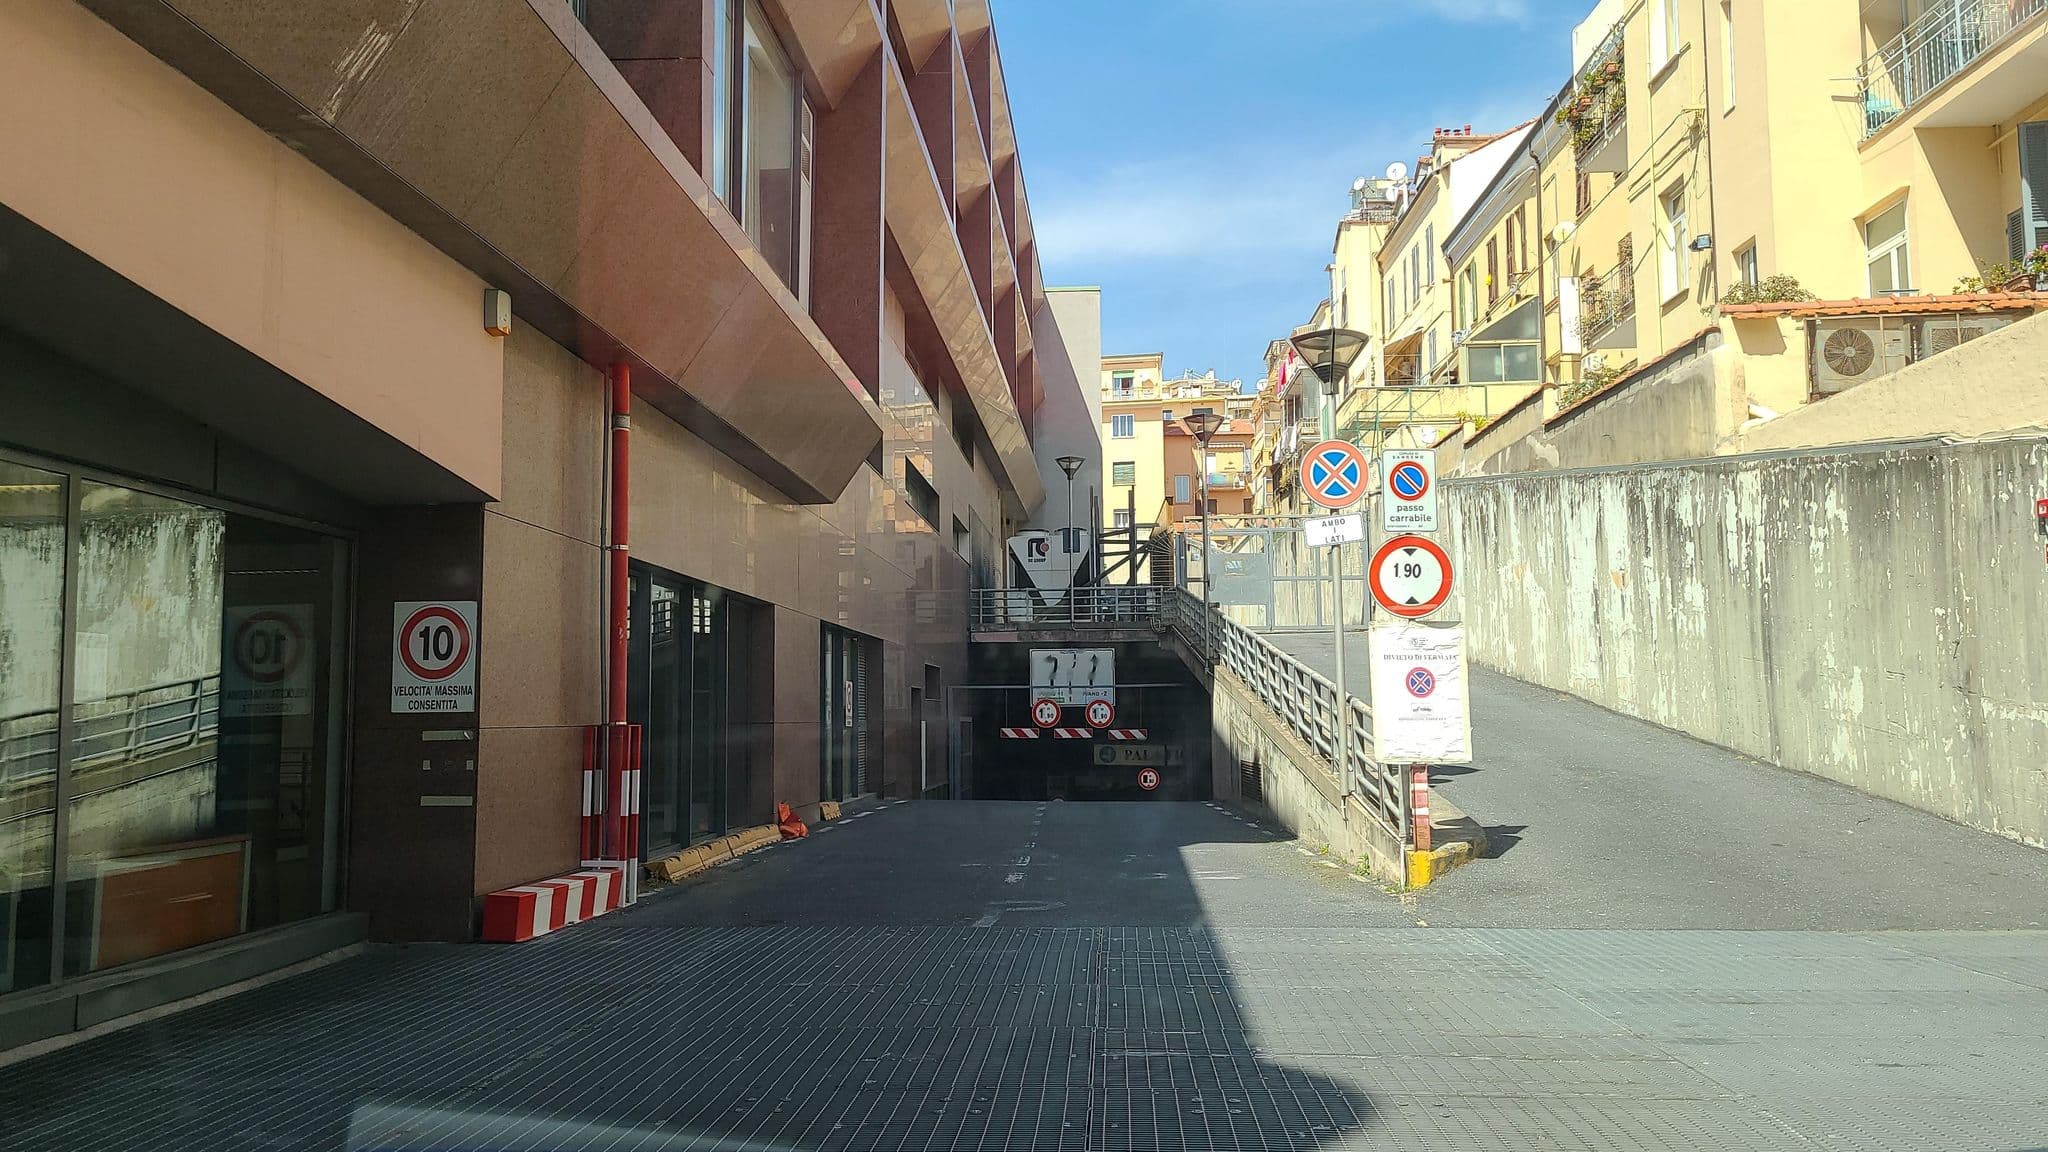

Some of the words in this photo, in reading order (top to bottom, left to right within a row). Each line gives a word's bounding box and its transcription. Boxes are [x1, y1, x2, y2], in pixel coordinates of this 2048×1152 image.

[1396, 504, 1425, 512] passo
[1389, 513, 1432, 522] carrabile
[1321, 518, 1346, 528] AMBO
[1325, 534, 1345, 544] LATI
[419, 625, 454, 661] 10
[393, 686, 433, 697] VELOCITA'
[434, 685, 473, 696] MASSIMA
[408, 700, 458, 710] CONSENTITA
